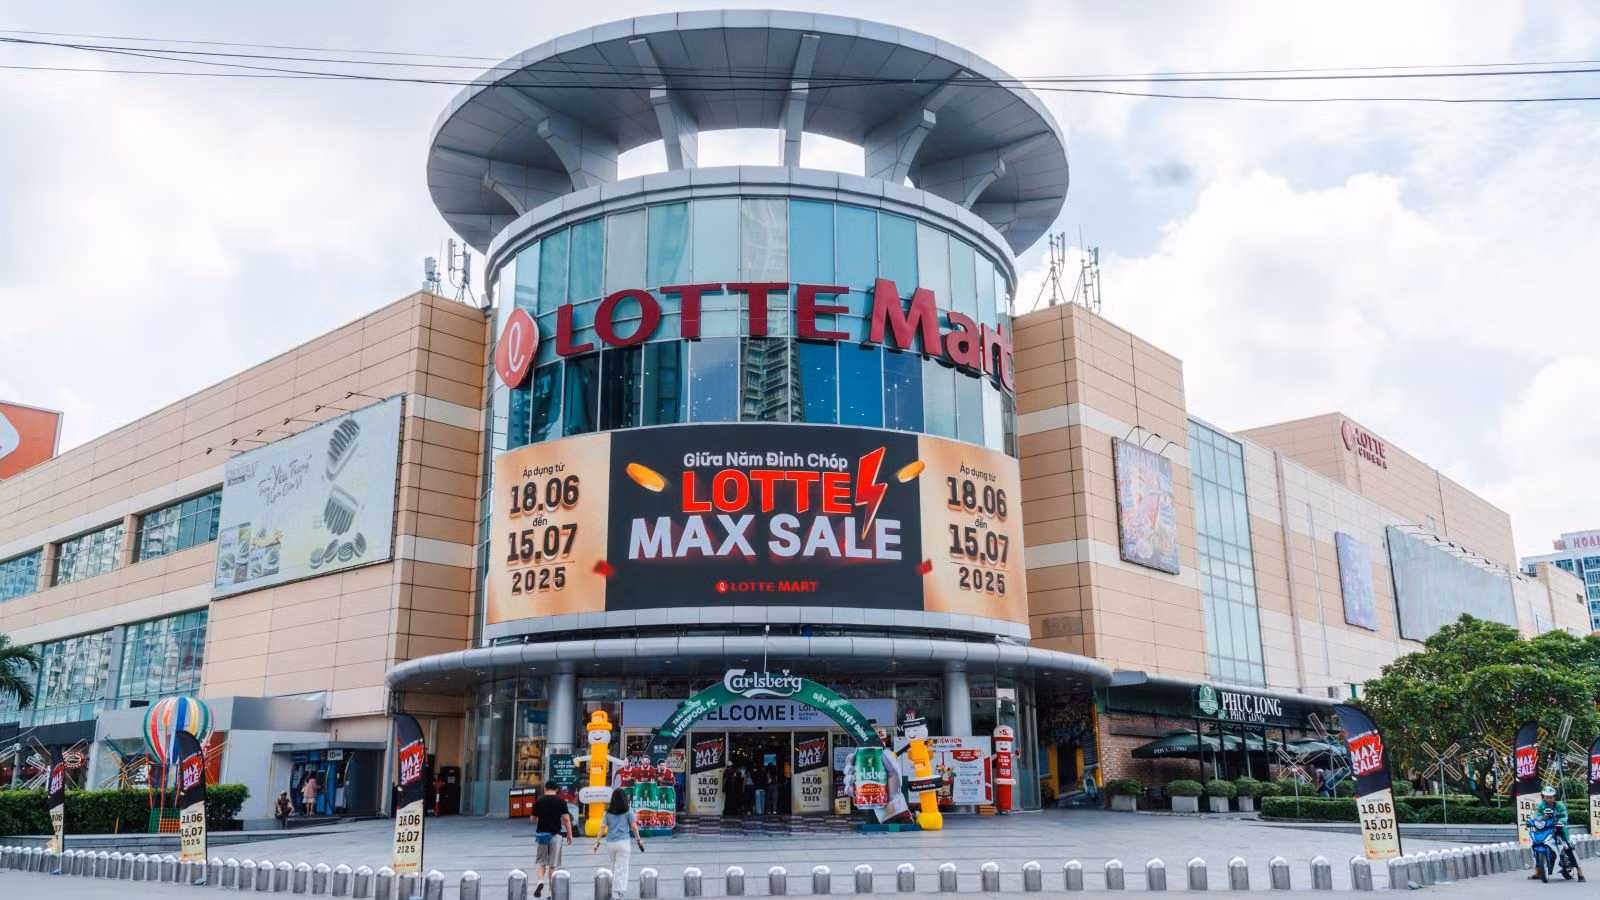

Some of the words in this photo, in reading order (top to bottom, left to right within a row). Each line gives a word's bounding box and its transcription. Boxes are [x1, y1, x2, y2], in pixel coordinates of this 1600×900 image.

[556, 282, 850, 357] LOTTE
[867, 277, 1015, 391] Mart
[1355, 428, 1386, 459] LOTTE
[683, 452, 723, 468] Giữa
[726, 452, 763, 467] Năm
[766, 451, 804, 467] Đỉnh
[807, 453, 848, 472] Chóp
[1358, 447, 1388, 470] CINEMA
[522, 466, 533, 479] Áp
[533, 465, 554, 477] dụng
[555, 462, 565, 472] từ
[959, 462, 971, 475] Áp
[971, 467, 988, 482] dụng
[510, 475, 579, 516] 18.06
[682, 469, 852, 513] LOTTE
[947, 476, 1008, 519] 18.06
[532, 514, 548, 527] đến
[974, 518, 988, 529] đến
[507, 523, 578, 562] 15.07
[628, 514, 756, 559] MAX
[768, 513, 902, 560] SALE
[949, 524, 1009, 564] 15.07
[511, 566, 566, 593] 2025
[730, 581, 775, 592] LOTTE
[778, 581, 818, 593] MART
[959, 566, 1006, 594] 2025
[724, 668, 803, 698] Carlsberg
[706, 704, 786, 721] ELCOME
[1221, 691, 1253, 714] PHUC
[1253, 695, 1283, 717] LONG
[671, 705, 707, 738] LIVERPOOL
[706, 698, 717, 709] FC
[836, 706, 857, 726] TUYỆT
[854, 724, 869, 742] ĐỈNH
[401, 752, 420, 772] MAX
[696, 747, 719, 759] MAX
[696, 756, 720, 768] SALE
[799, 747, 821, 759] MAX
[799, 756, 822, 767] SALE
[1350, 743, 1376, 763] MAX
[1516, 755, 1533, 766] MAX
[183, 763, 199, 779] MAX
[401, 764, 420, 785] SALE
[1352, 755, 1380, 775] SALE
[1516, 765, 1534, 777] SALE
[183, 774, 199, 790] SALE
[1361, 803, 1392, 815] 18.06
